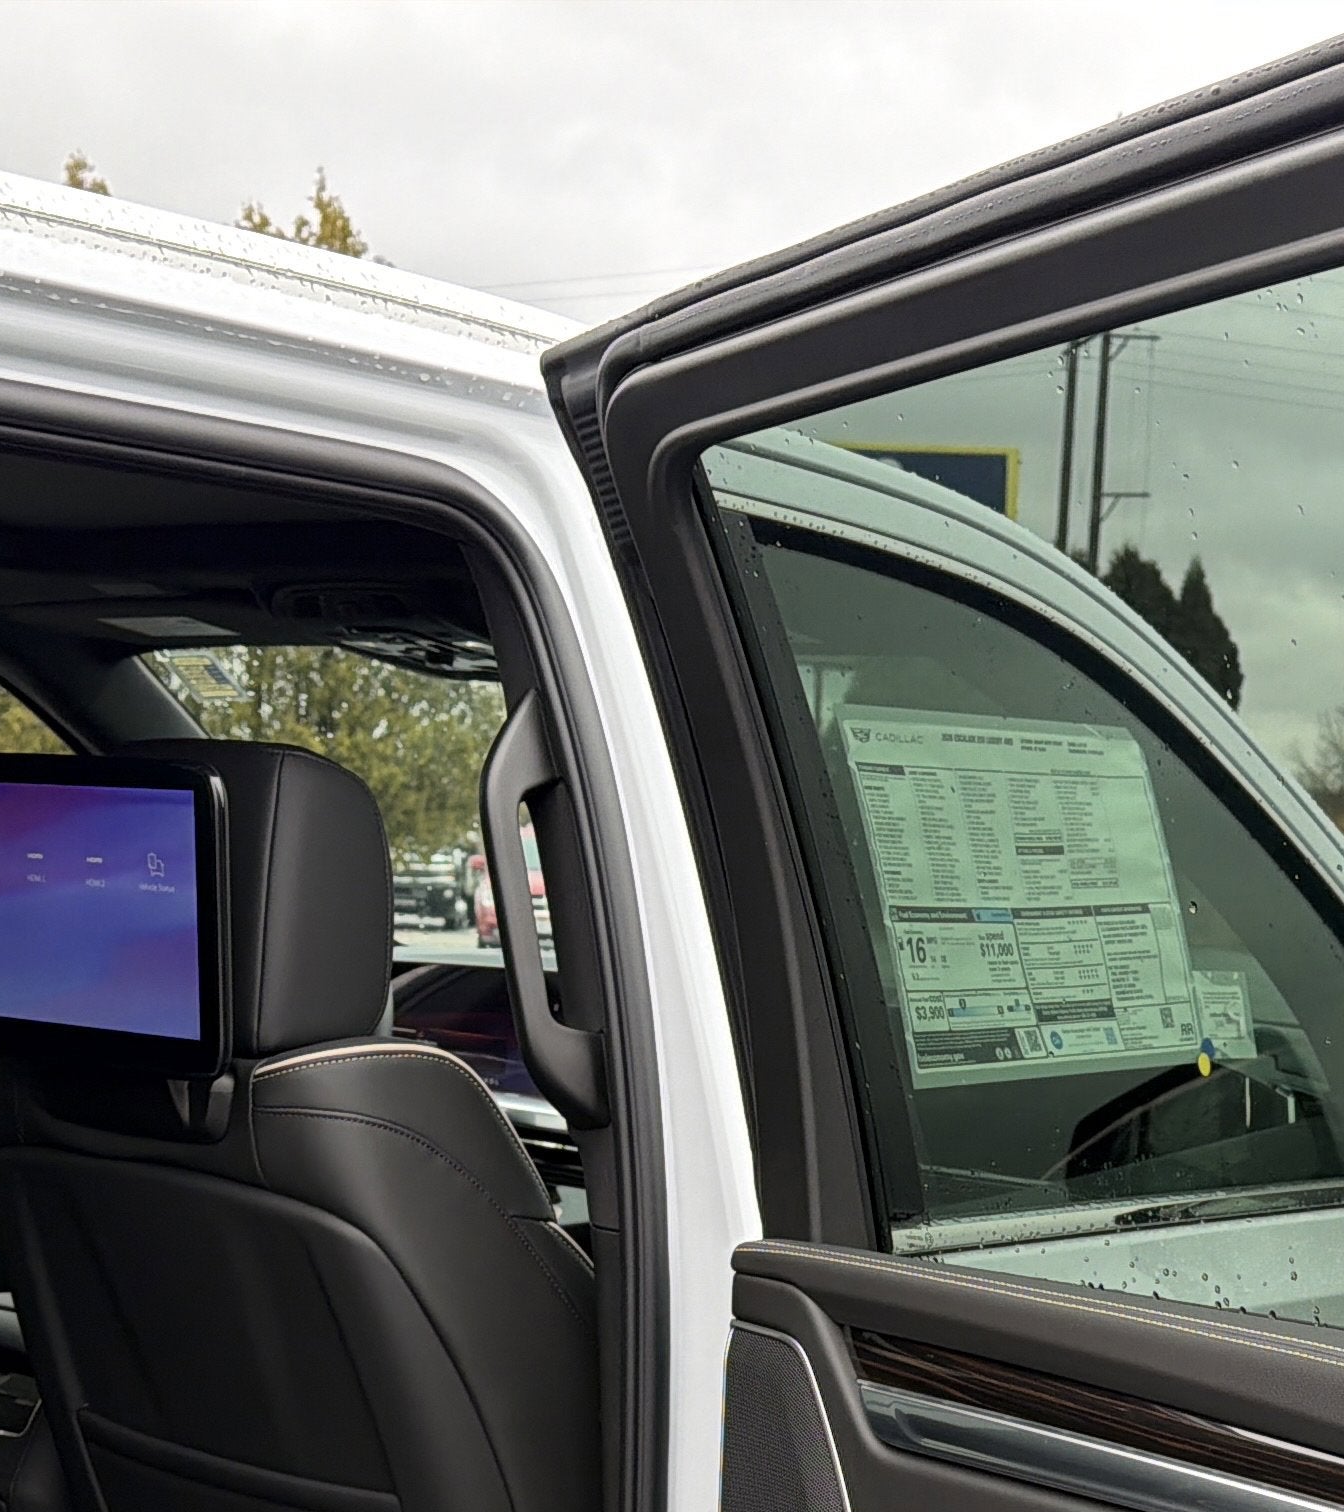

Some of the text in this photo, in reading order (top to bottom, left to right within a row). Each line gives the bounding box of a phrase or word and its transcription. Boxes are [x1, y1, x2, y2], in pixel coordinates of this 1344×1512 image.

[875, 732, 924, 745] CADILLAC
[907, 936, 927, 964] 16
[980, 943, 1014, 959] $11,000
[915, 1005, 945, 1021] $3,900
